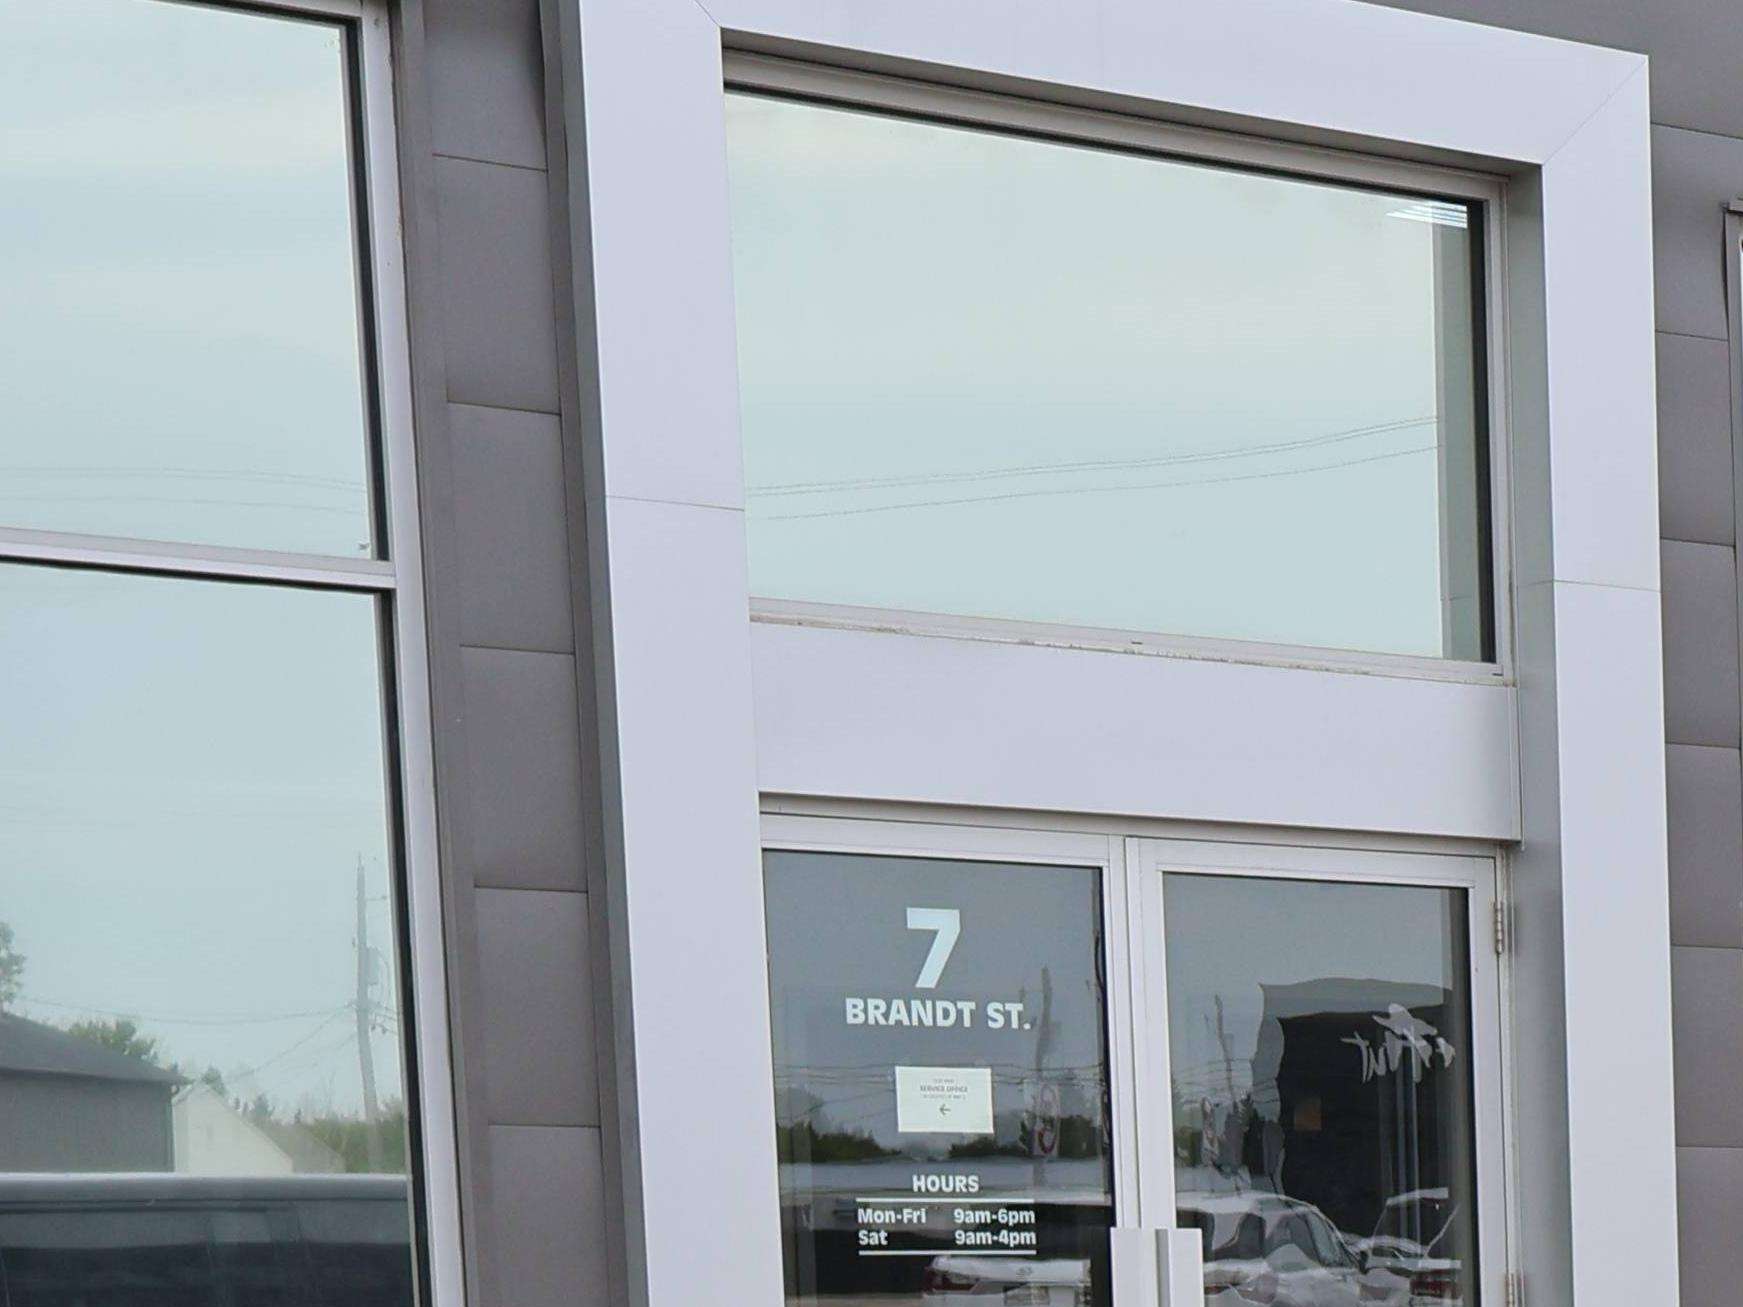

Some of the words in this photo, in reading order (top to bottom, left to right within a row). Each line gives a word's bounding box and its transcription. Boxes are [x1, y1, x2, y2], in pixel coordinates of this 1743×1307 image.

[906, 907, 961, 989] 7
[845, 998, 976, 1028] BRANDT
[987, 1003, 1031, 1030] ST.
[912, 1174, 980, 1193] HOURS
[857, 1208, 926, 1224] Mon-Fri
[953, 1208, 1035, 1226] 9am-6pm
[858, 1230, 888, 1246] Sat
[955, 1230, 1037, 1247] 9am-4pm
